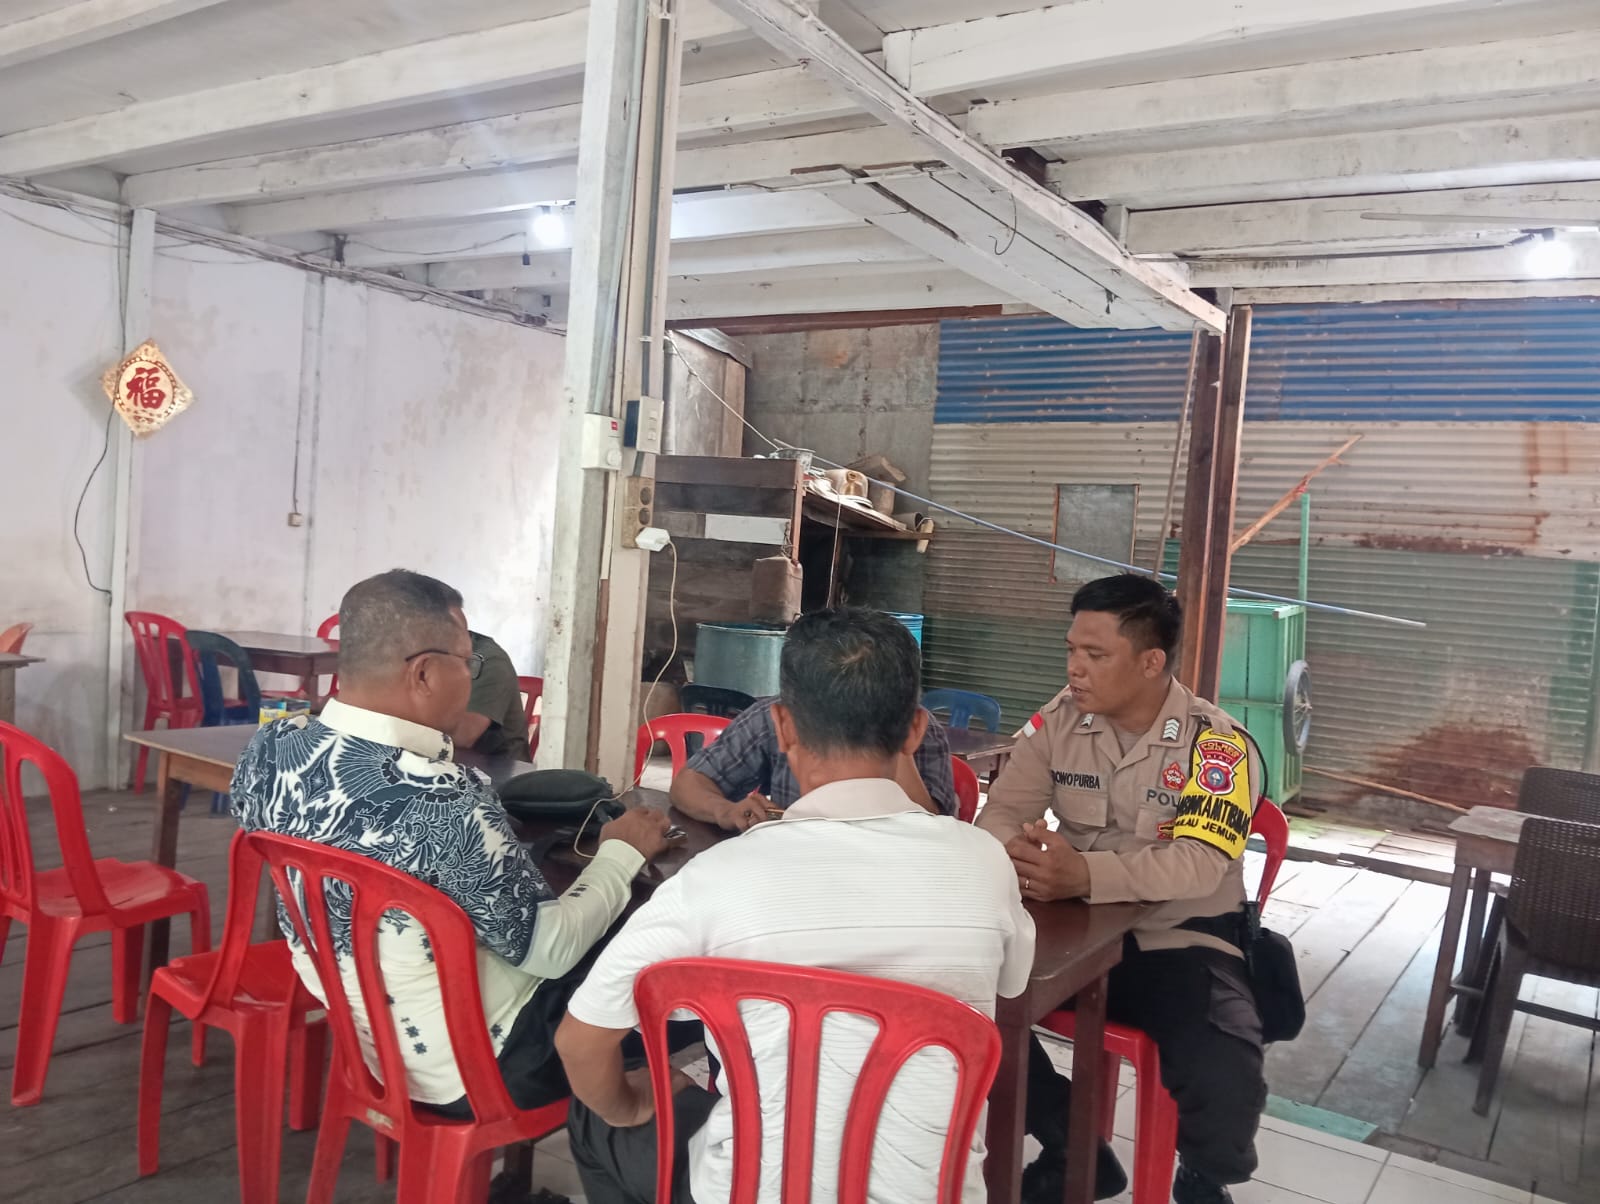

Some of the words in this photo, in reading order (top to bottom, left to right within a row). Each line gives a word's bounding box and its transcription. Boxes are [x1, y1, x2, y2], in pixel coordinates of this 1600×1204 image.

[126, 366, 166, 410] 福
[1207, 754, 1231, 763] RIAU
[1073, 773, 1100, 789] PURBA
[1146, 788, 1177, 807] POL
[1175, 817, 1199, 828] ULAU
[1202, 821, 1238, 845] JEMUR
